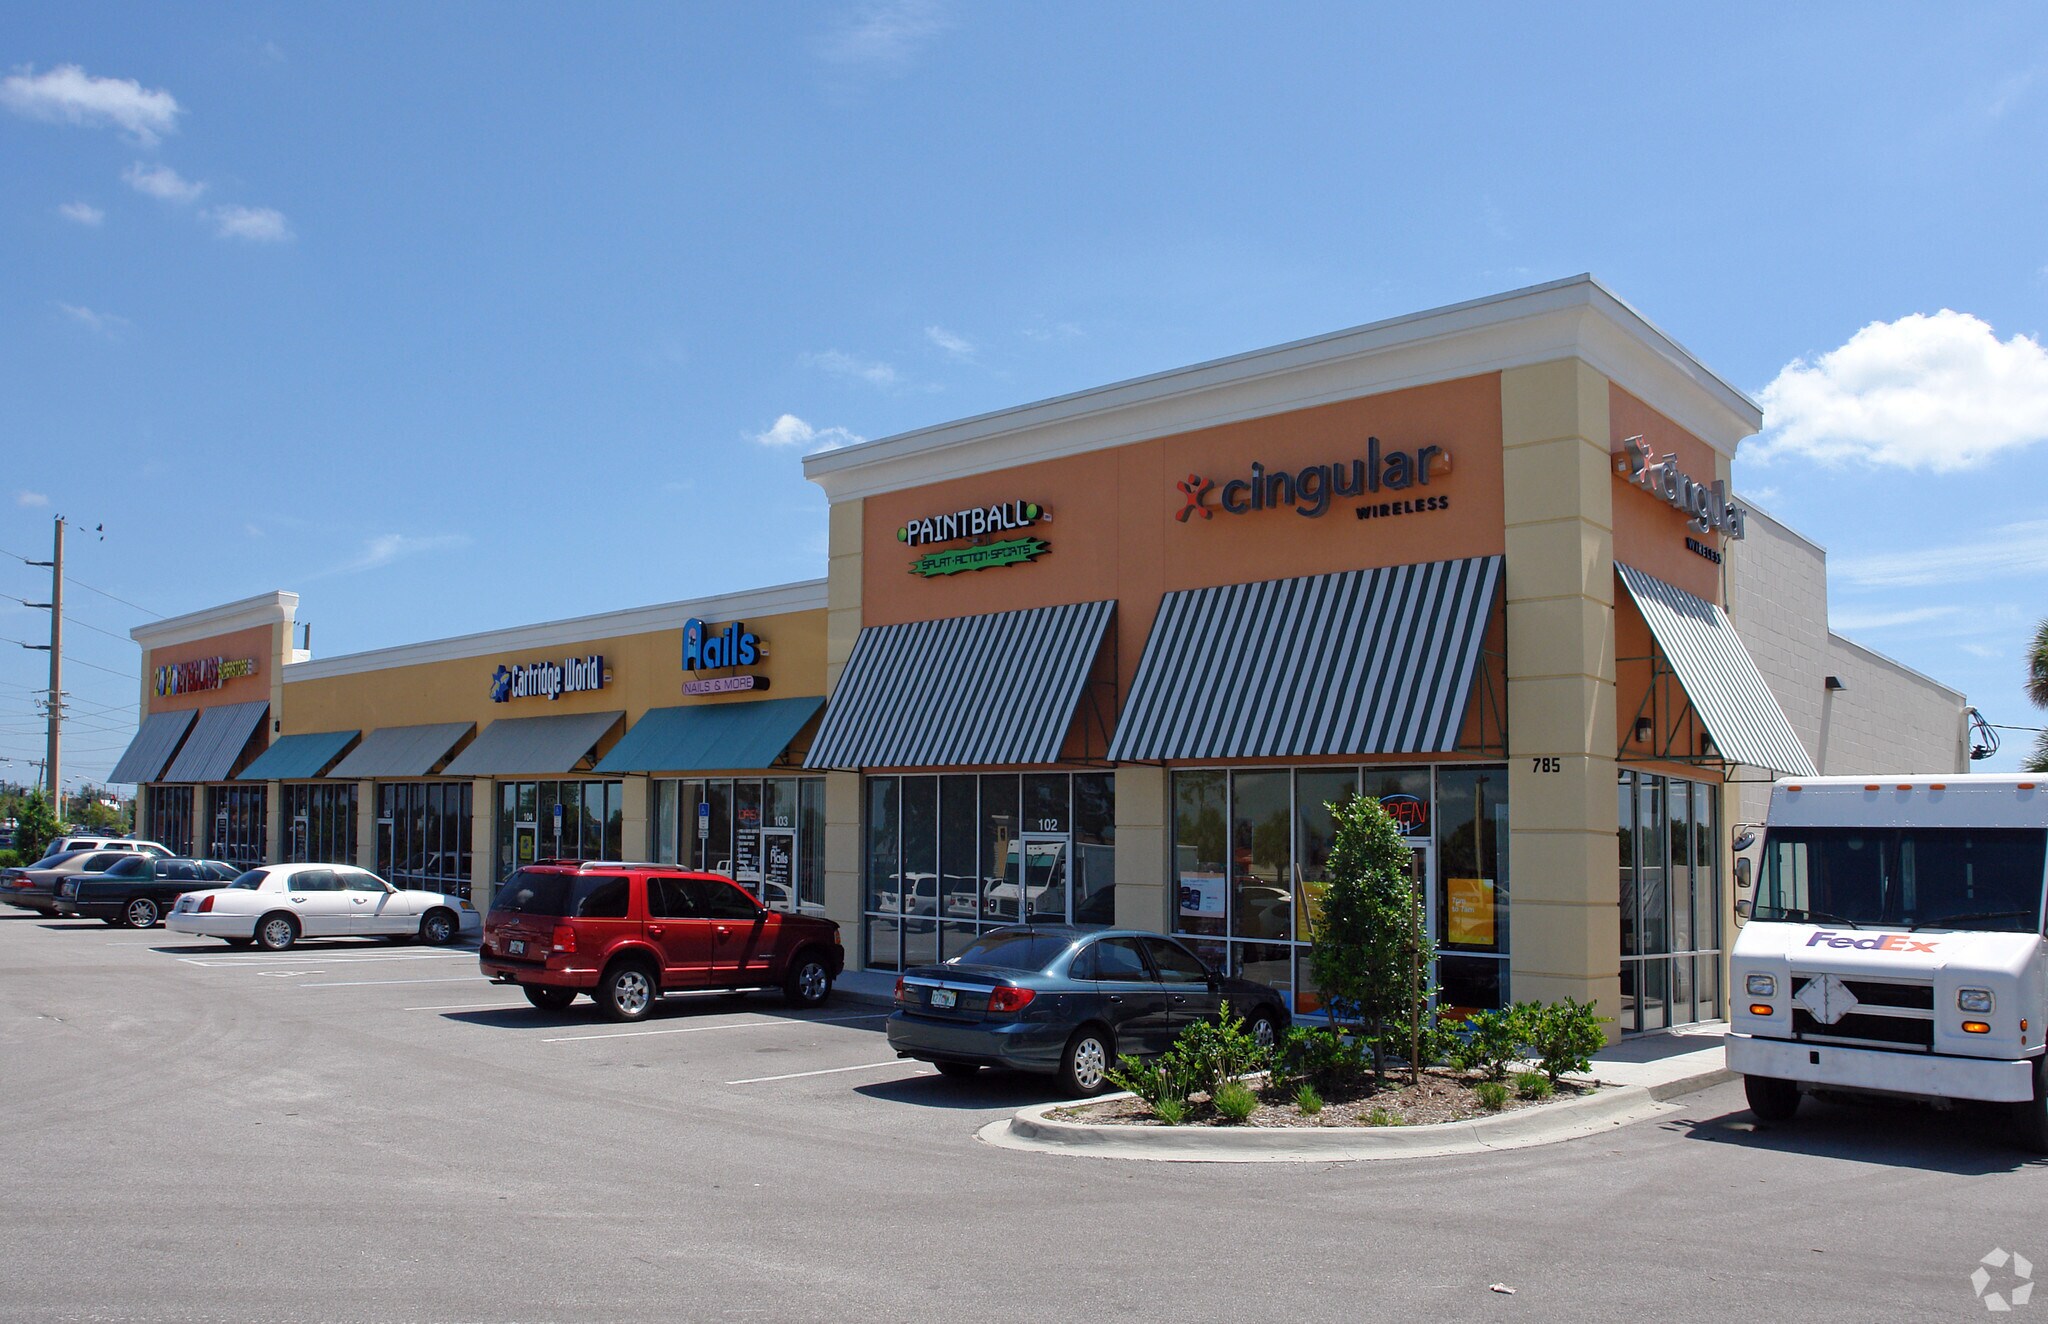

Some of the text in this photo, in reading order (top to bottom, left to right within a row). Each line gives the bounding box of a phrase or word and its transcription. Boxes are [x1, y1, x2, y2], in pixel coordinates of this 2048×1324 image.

[1222, 436, 1442, 518] cingular
[1356, 496, 1449, 520] WIRELESS
[907, 500, 1030, 546] PAINTBALL
[511, 656, 601, 700] Cartridge World
[684, 677, 752, 693] NAILS & MORE
[1532, 757, 1560, 773] 785
[774, 816, 788, 827] 103
[1038, 818, 1058, 831] 102
[1805, 931, 1940, 953] FedEx
